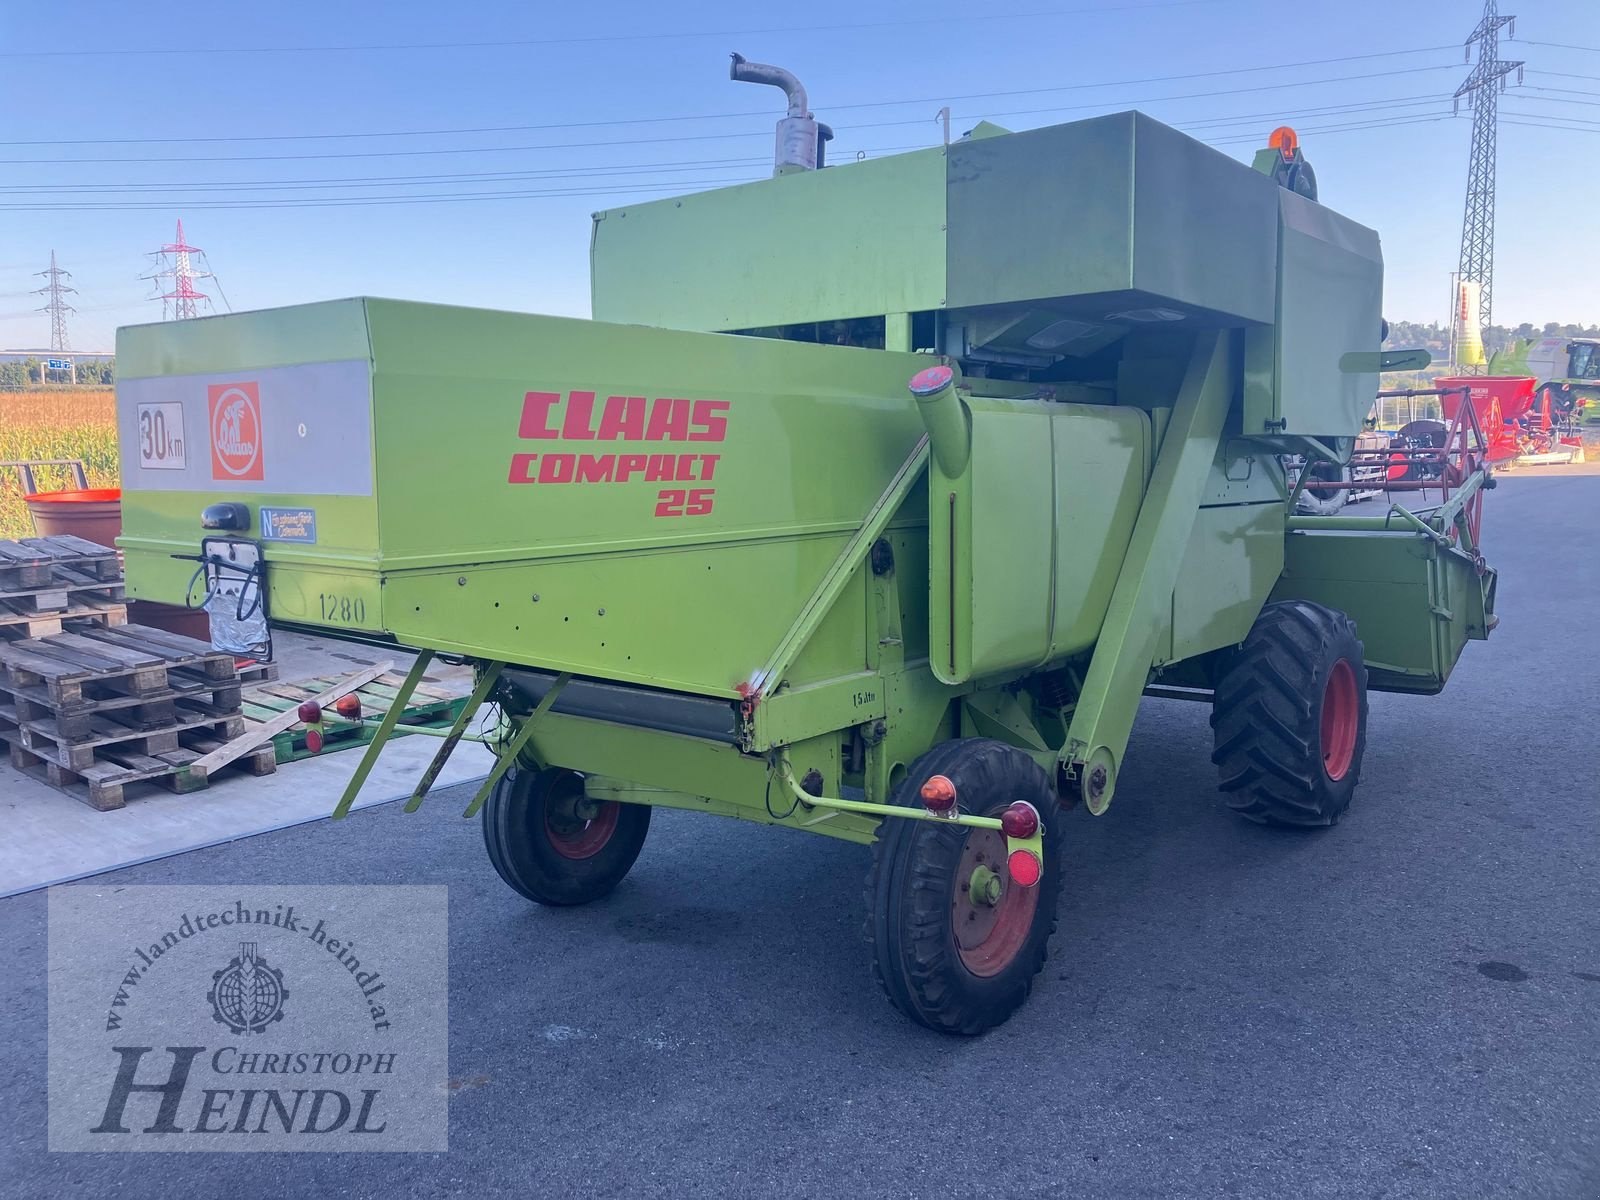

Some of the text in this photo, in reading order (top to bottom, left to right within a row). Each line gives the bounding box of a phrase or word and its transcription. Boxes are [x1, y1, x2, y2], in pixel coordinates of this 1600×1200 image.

[518, 391, 730, 442] CLAAS
[508, 453, 721, 484] COMPACT
[654, 489, 716, 517] 25
[320, 593, 365, 623] 1280
